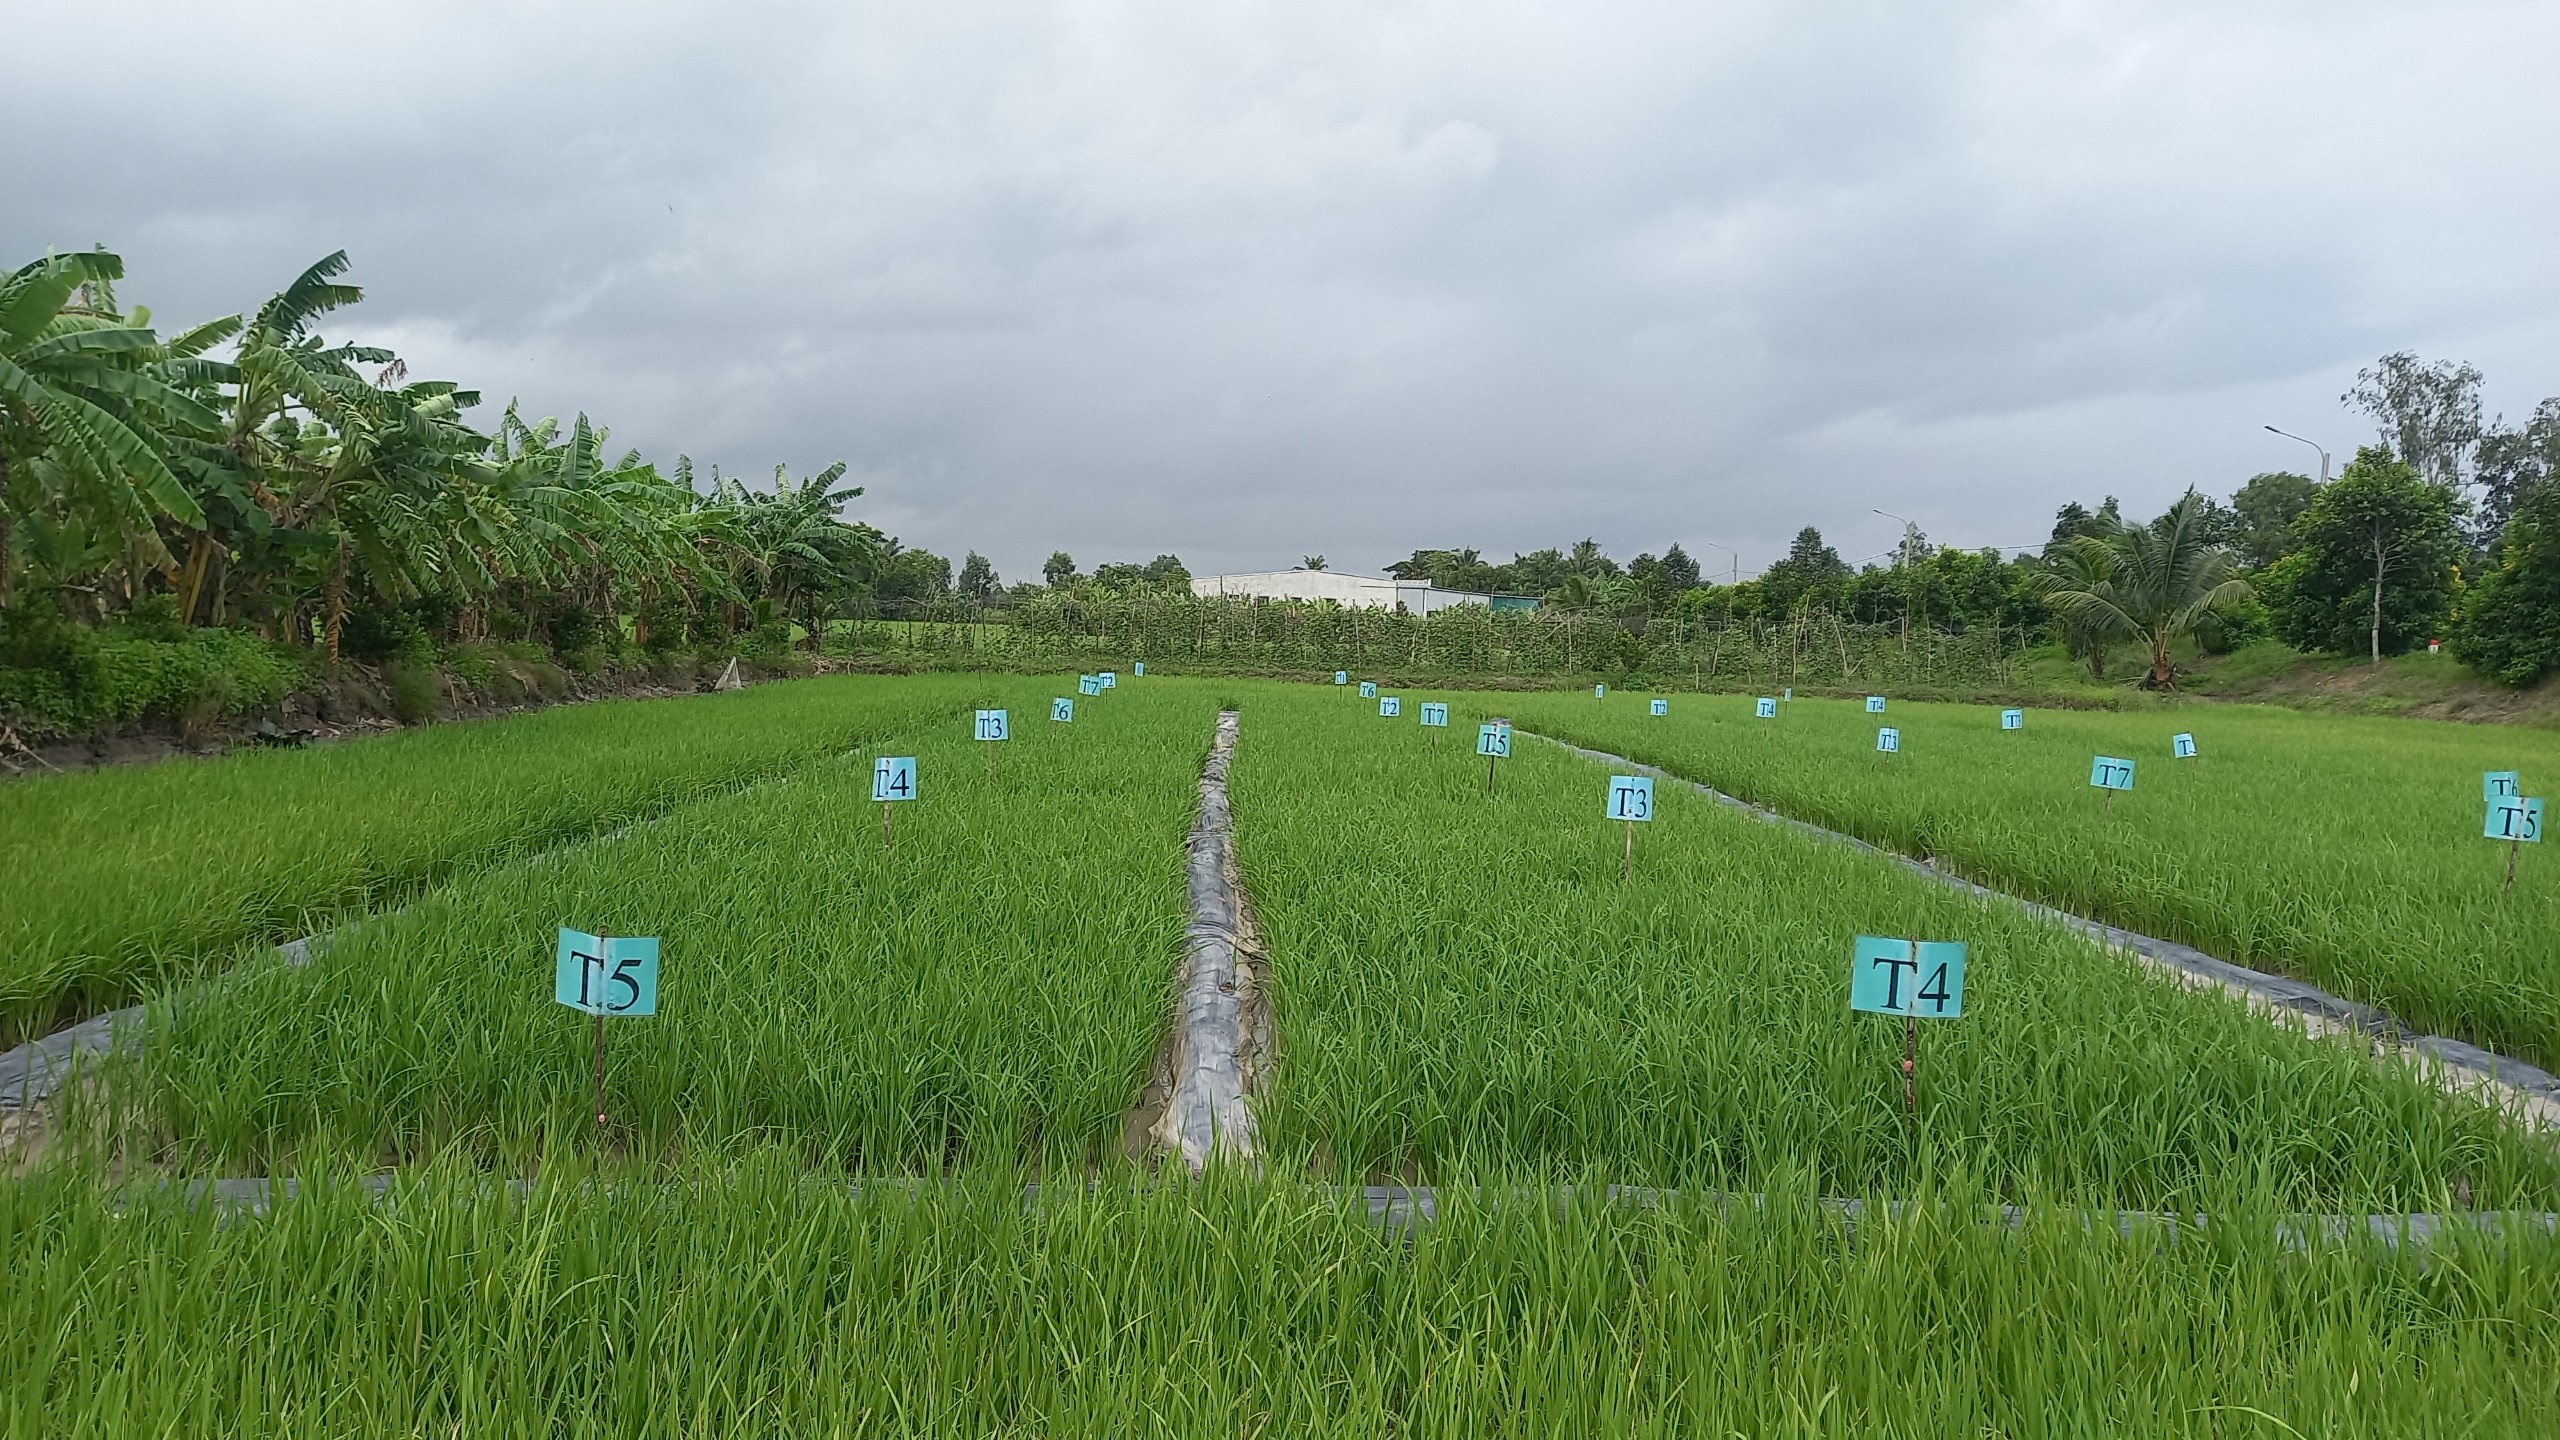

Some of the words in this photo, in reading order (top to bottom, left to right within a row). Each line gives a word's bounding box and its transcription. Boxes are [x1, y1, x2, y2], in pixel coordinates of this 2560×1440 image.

[1083, 680, 1099, 694] T7
[1101, 676, 1113, 687] T2
[1362, 685, 1374, 697] T6
[1051, 702, 1069, 720] T6
[1384, 702, 1397, 714] T2
[1654, 703, 1666, 714] T2
[1761, 703, 1774, 716] T4
[1870, 700, 1883, 711] T4
[1425, 708, 1445, 723] T7
[979, 718, 1003, 738] T3
[1484, 733, 1506, 754] T5
[1882, 734, 1897, 750] T3
[876, 768, 910, 798] T4
[2099, 764, 2131, 788] T7
[1615, 787, 1647, 818] T3
[2497, 806, 2537, 838] T5
[570, 950, 642, 1011] T5
[1873, 957, 1950, 1013] T4
